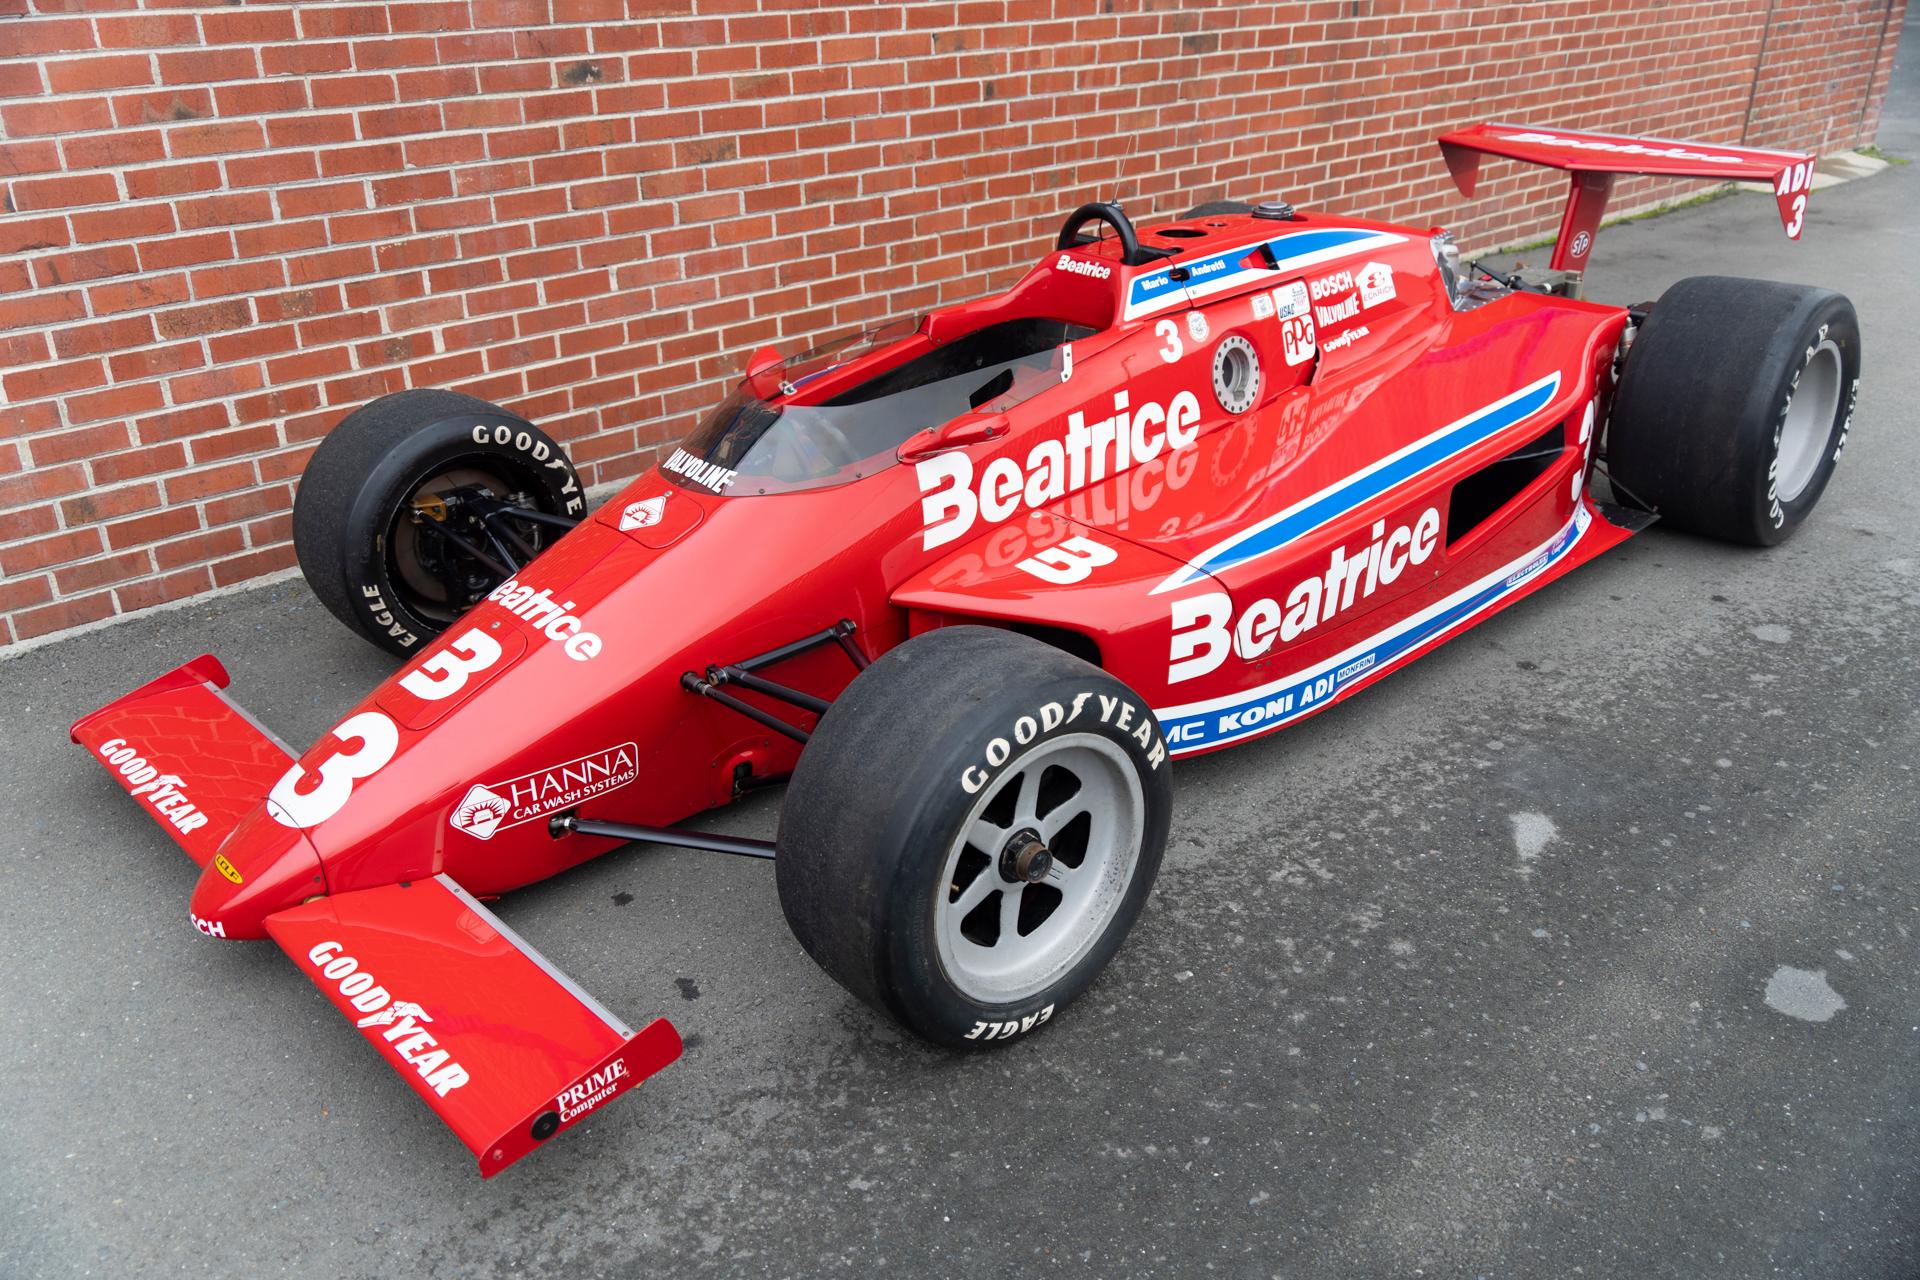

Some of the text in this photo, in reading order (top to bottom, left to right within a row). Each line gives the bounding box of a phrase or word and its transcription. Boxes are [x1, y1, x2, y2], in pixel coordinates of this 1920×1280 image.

[1777, 160, 1814, 196] ADI
[1787, 195, 1806, 240] 3
[1572, 234, 1589, 254] STP
[1056, 254, 1111, 280] Beatrice
[1141, 259, 1226, 291] Mario Andretti
[1311, 270, 1353, 300] BOSCH
[1279, 303, 1295, 319] USAC
[1315, 292, 1360, 328] VALVOLINE
[1155, 319, 1183, 363] 3
[1284, 317, 1314, 355] PPG
[472, 424, 583, 515] GOODYE
[662, 447, 738, 494] VALVOLINE
[915, 389, 1200, 552] Beatrice
[1014, 535, 1118, 585] 3
[362, 584, 418, 648] EAGLE
[1168, 506, 1440, 685] Beatrice
[488, 579, 602, 662] eatrice
[398, 627, 502, 700] 3
[1338, 655, 1374, 680] MONFRINI
[1300, 673, 1335, 706] ADI
[1219, 694, 1293, 734] KONI
[961, 692, 1167, 794] GOODYEAR
[99, 738, 208, 835] GOODYEAR
[267, 712, 399, 828] 3
[511, 749, 633, 807] HANNA
[513, 769, 635, 820] CAR WASH SYSTEMS
[308, 941, 470, 1098] GOODYEAR
[964, 1004, 1055, 1041] EAGLE
[560, 1082, 618, 1123] Computer
